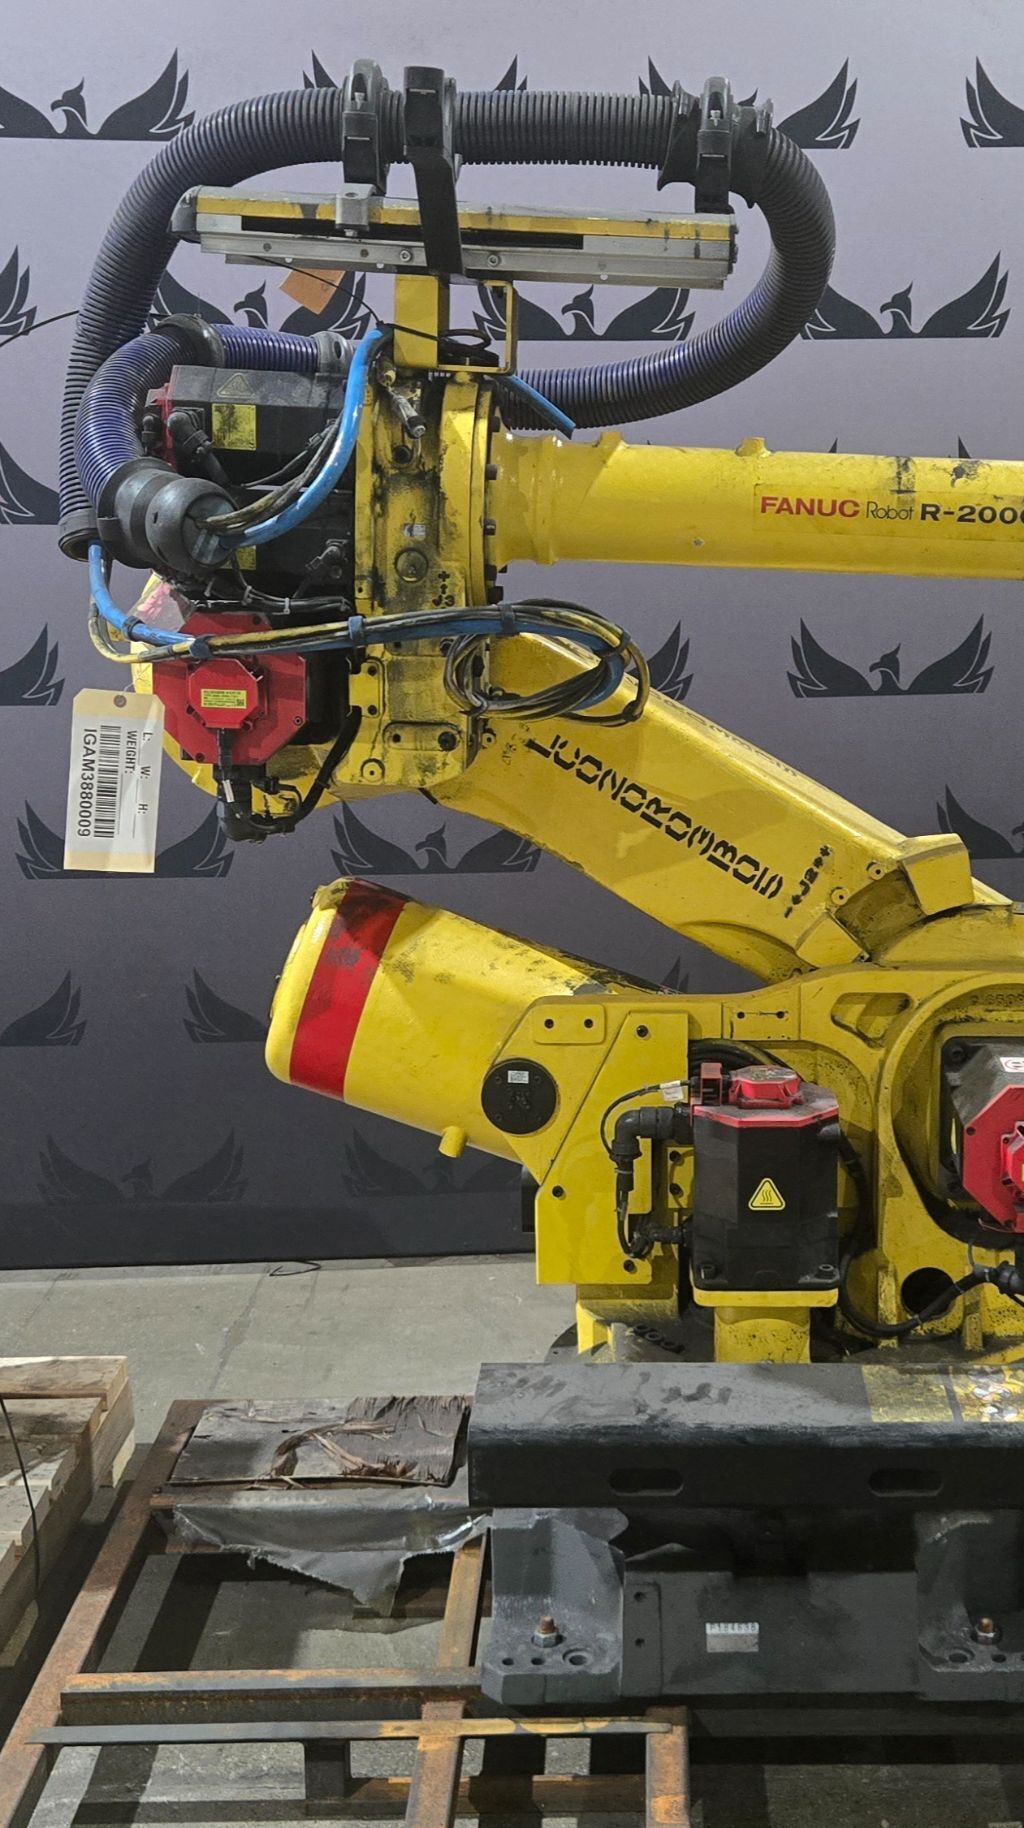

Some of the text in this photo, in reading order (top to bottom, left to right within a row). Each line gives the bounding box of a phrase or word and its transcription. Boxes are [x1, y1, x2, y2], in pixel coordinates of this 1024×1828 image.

[760, 496, 860, 518] FANUC
[866, 501, 914, 521] Robot
[124, 729, 138, 774] WEIGHT:
[77, 728, 98, 837] IGAM3880009
